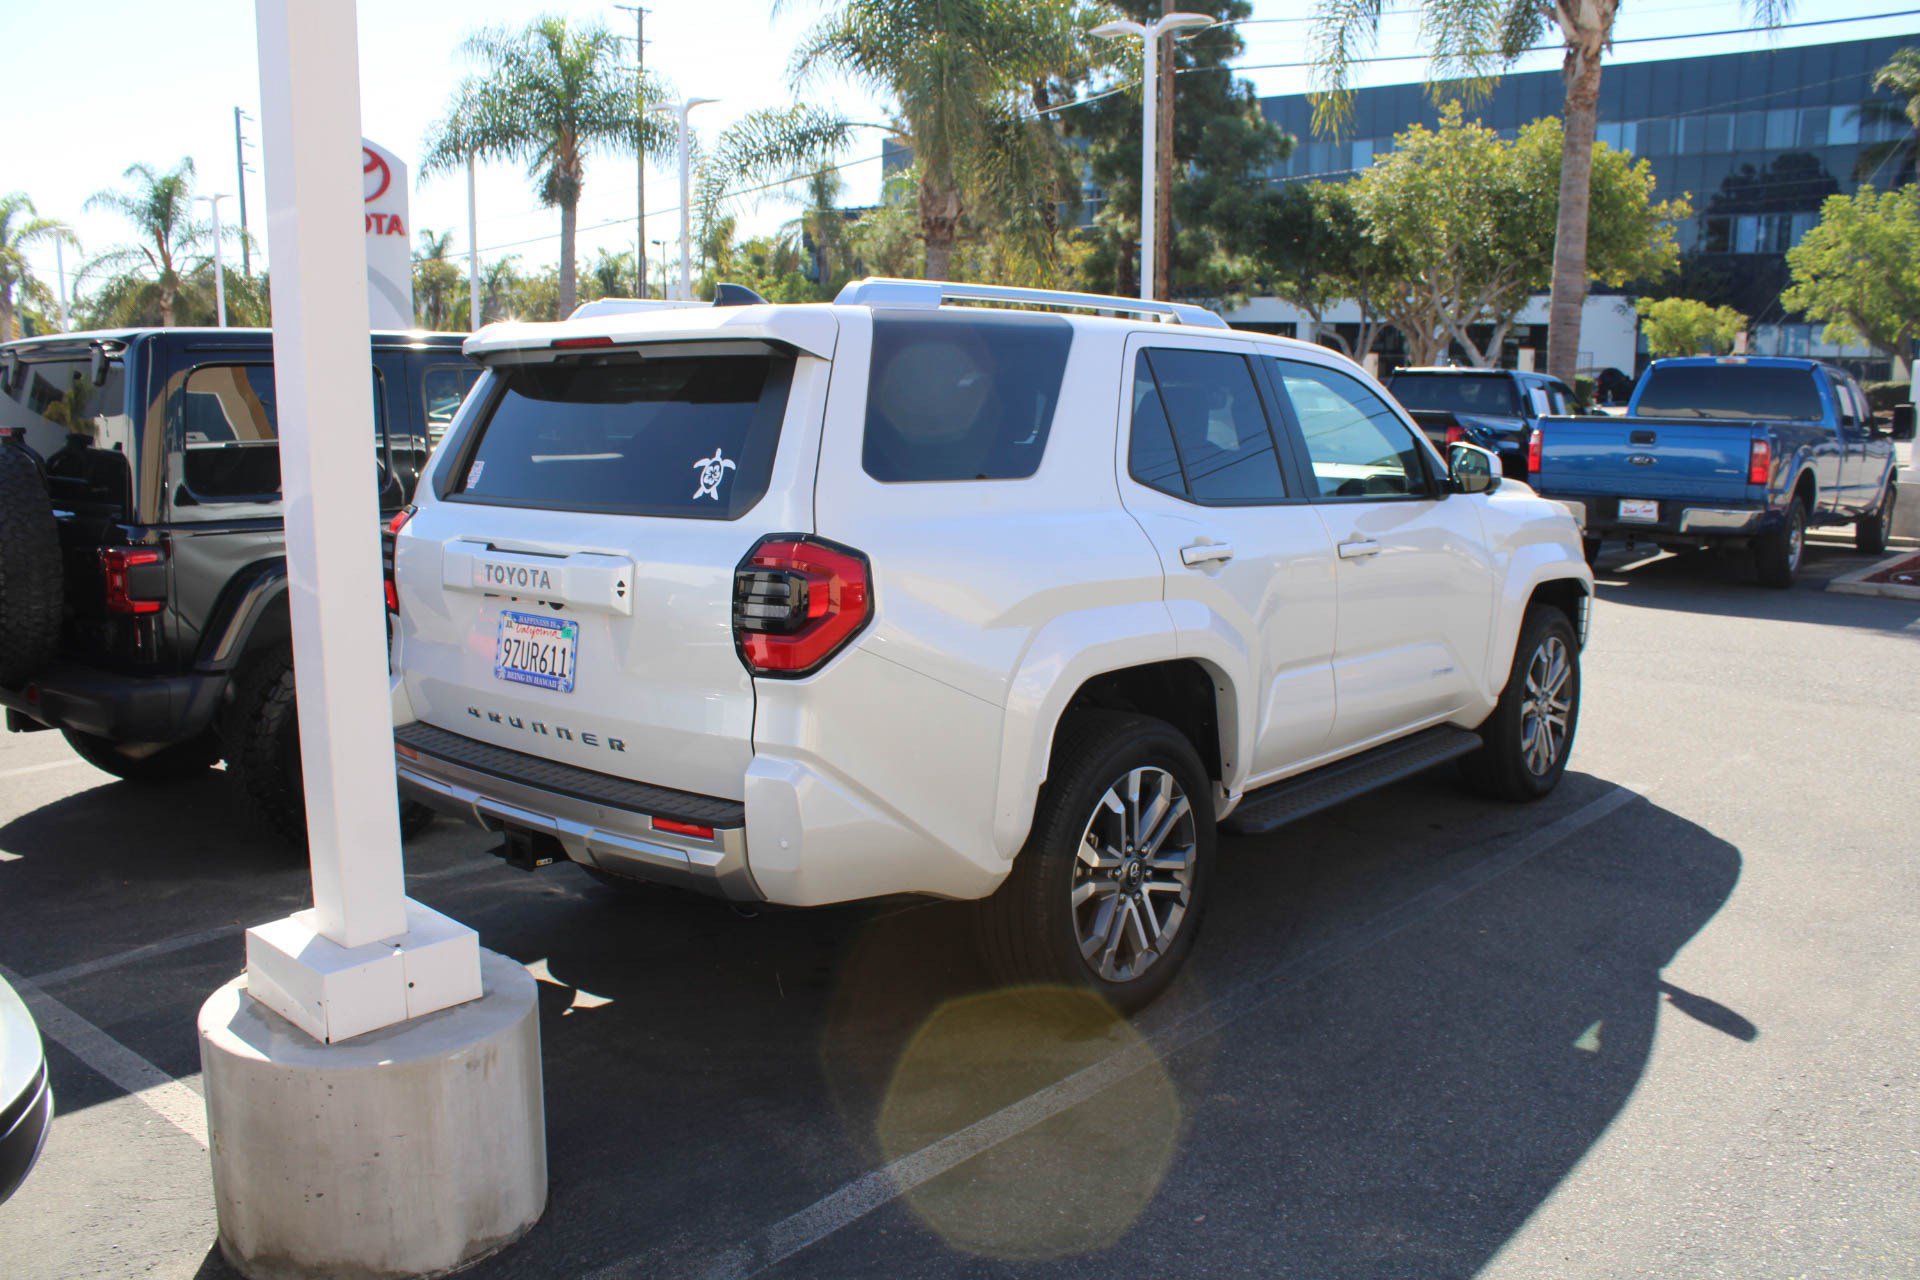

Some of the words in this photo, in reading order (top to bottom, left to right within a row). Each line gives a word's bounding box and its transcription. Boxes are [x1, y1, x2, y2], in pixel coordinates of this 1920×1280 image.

[485, 564, 551, 590] TOYOTA
[515, 624, 561, 640] California
[502, 638, 566, 677] 9ZUR611
[506, 671, 525, 681] BEING
[526, 675, 533, 683] IN
[534, 677, 557, 688] HAWAII
[467, 706, 626, 752] 4RUNNER
